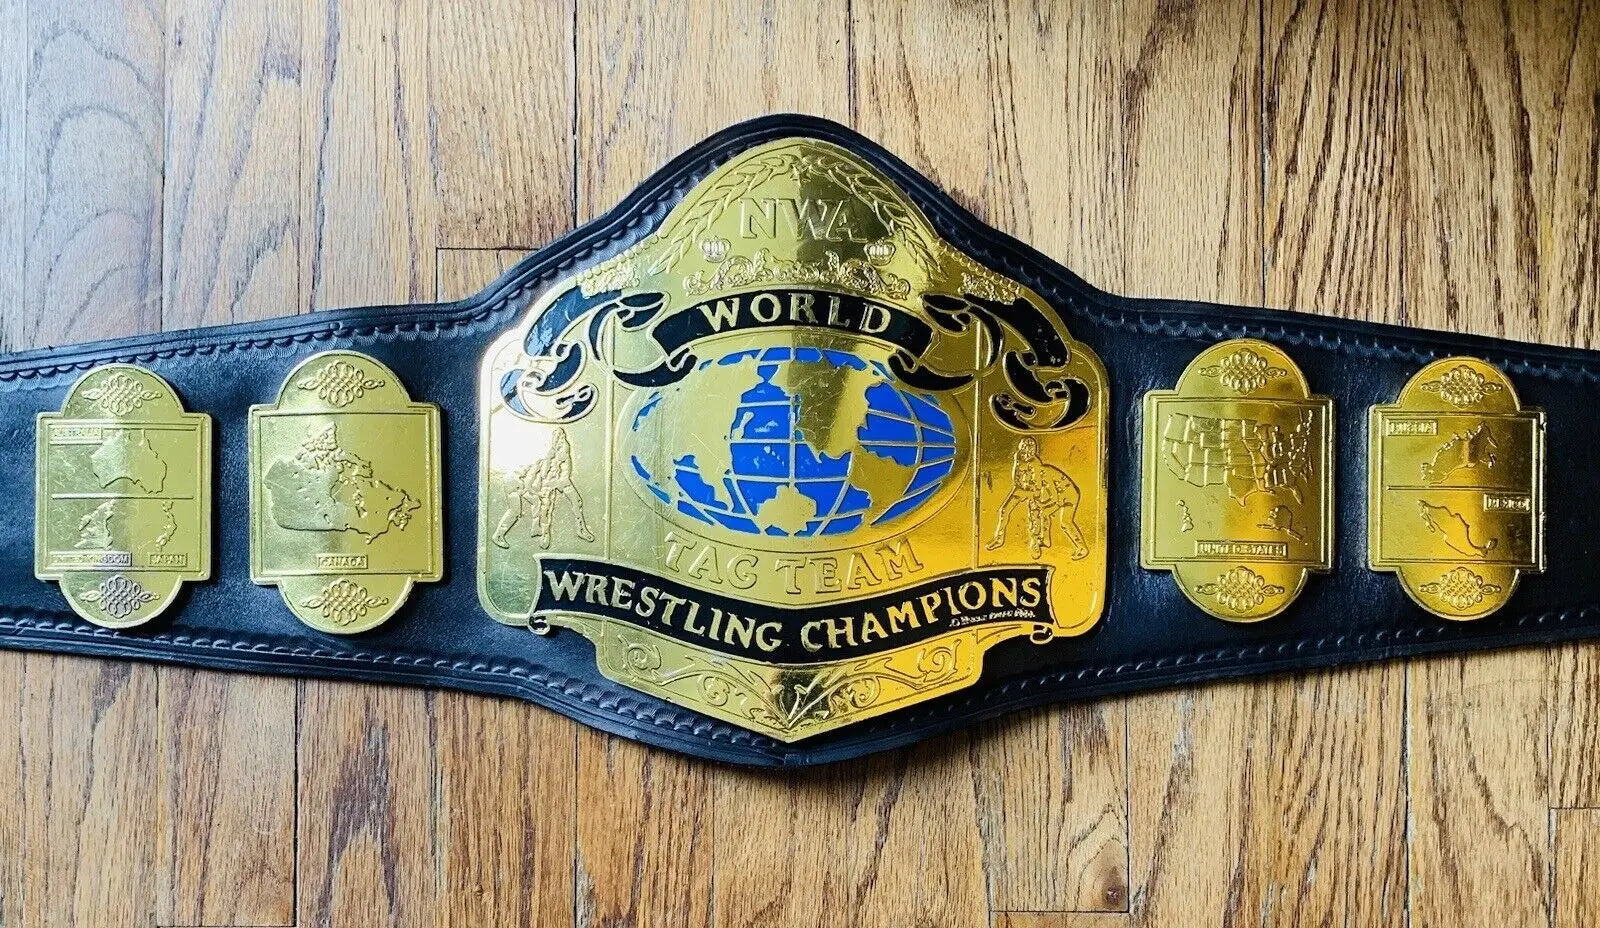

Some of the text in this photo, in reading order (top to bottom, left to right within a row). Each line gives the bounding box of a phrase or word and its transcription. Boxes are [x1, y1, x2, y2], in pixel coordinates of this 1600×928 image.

[739, 198, 868, 242] NWA
[697, 292, 891, 333] WORLD
[664, 532, 924, 594] TAG TEAM
[543, 570, 1042, 652] WRESTLING CHAMPIONS
